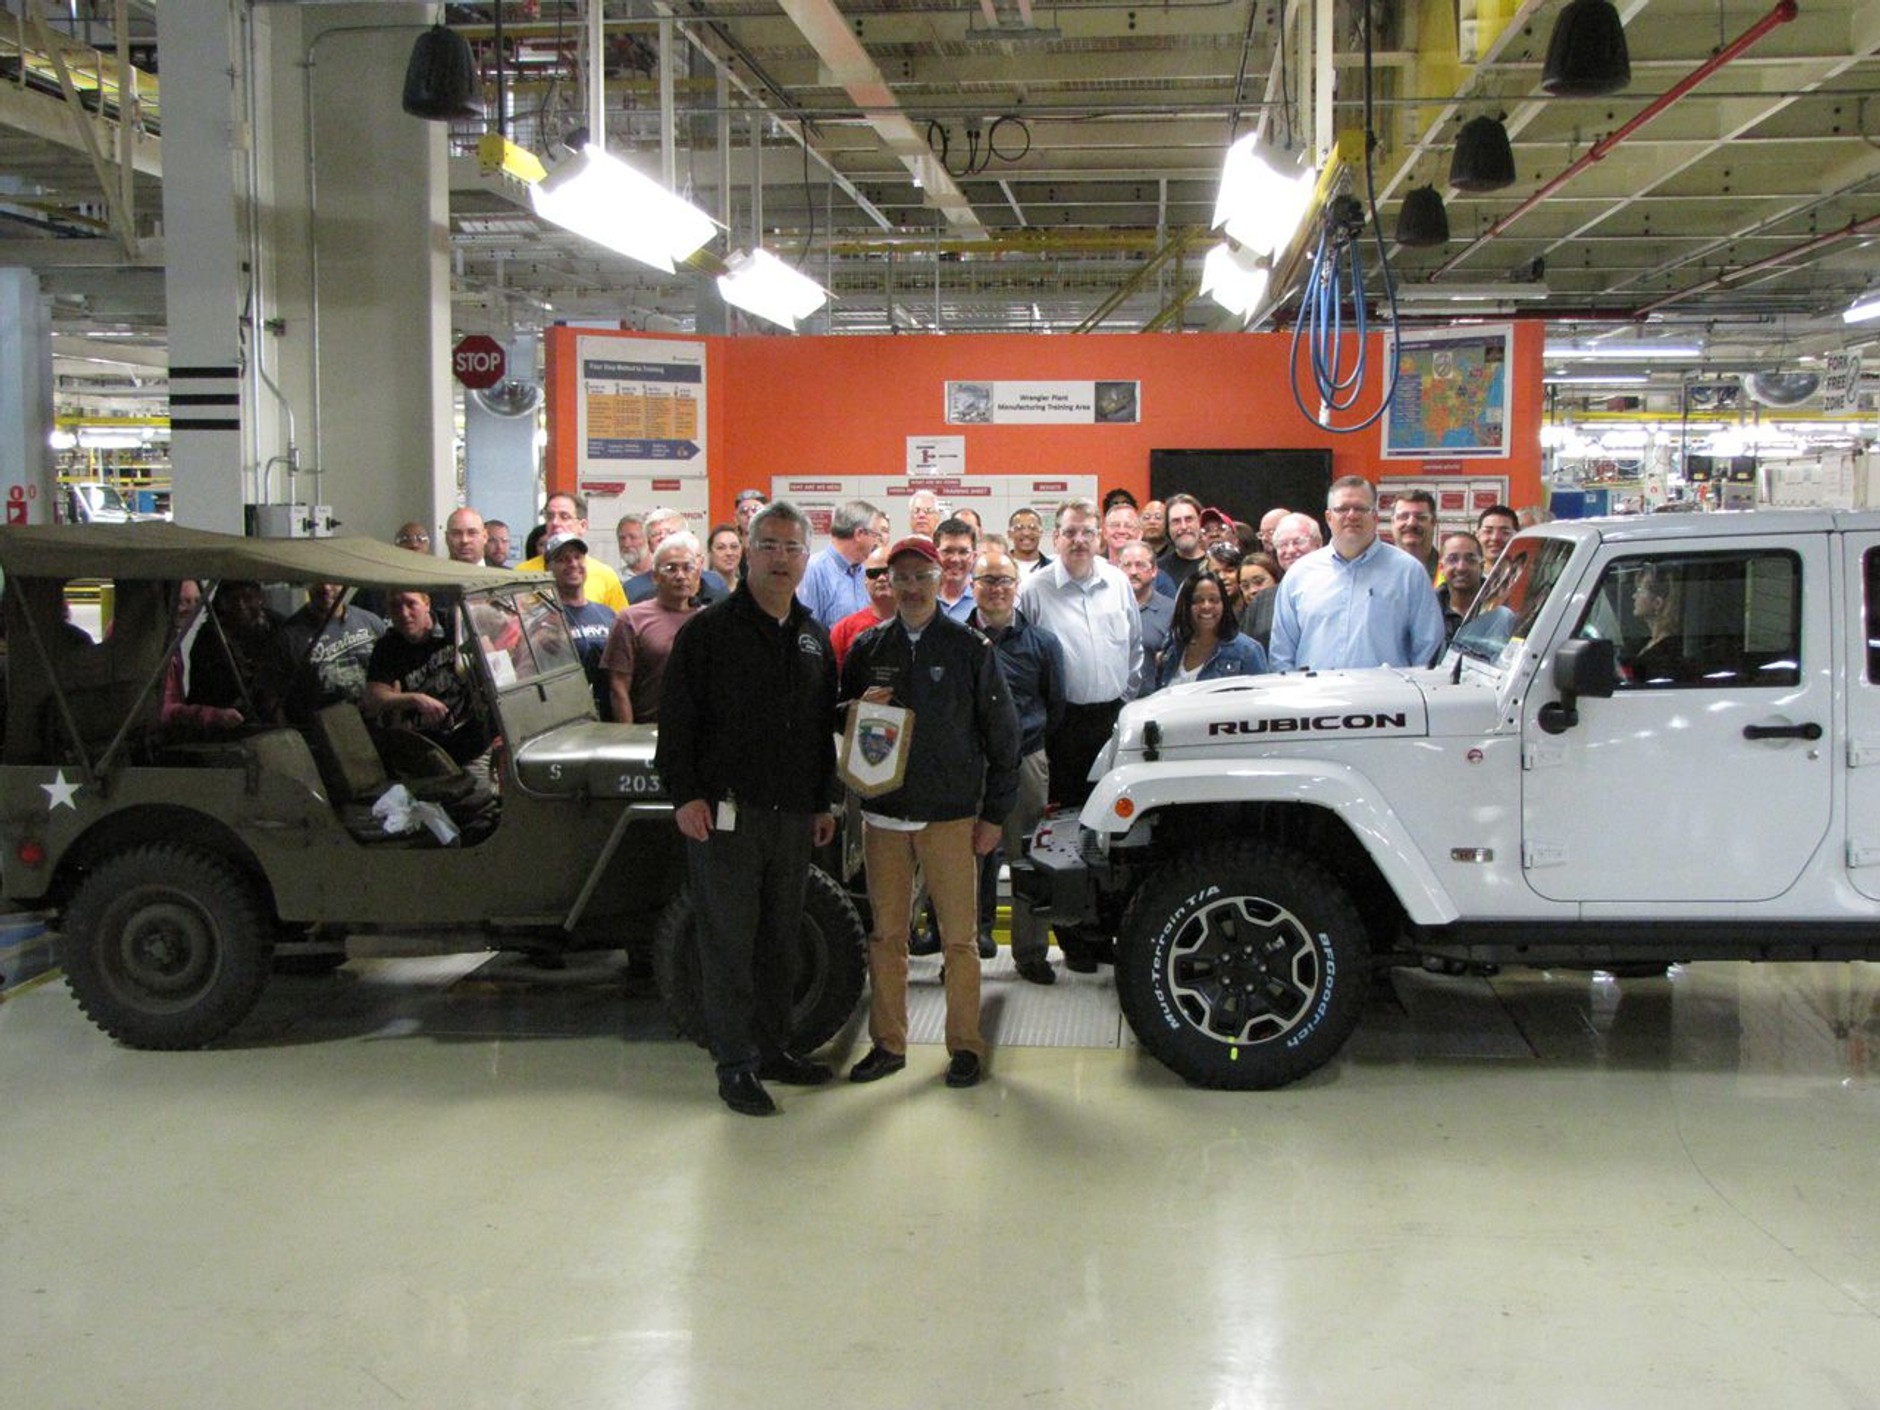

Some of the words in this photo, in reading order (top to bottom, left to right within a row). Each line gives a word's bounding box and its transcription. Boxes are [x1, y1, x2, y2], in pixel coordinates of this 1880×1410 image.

[456, 352, 501, 371] STOP
[1827, 355, 1849, 370] FORK
[1826, 374, 1847, 391] FREE
[1020, 394, 1050, 402] Wrangler
[1825, 395, 1846, 411] ZONE
[997, 403, 1046, 411] Manufacturing
[1047, 403, 1074, 411] Training
[1208, 713, 1406, 736] RUBICON
[550, 763, 562, 780] S
[619, 775, 660, 793] 203
[1152, 906, 1186, 1029] Mud-Terrain
[1187, 885, 1221, 906] T/A
[1287, 932, 1336, 1048] BFGoodrich
